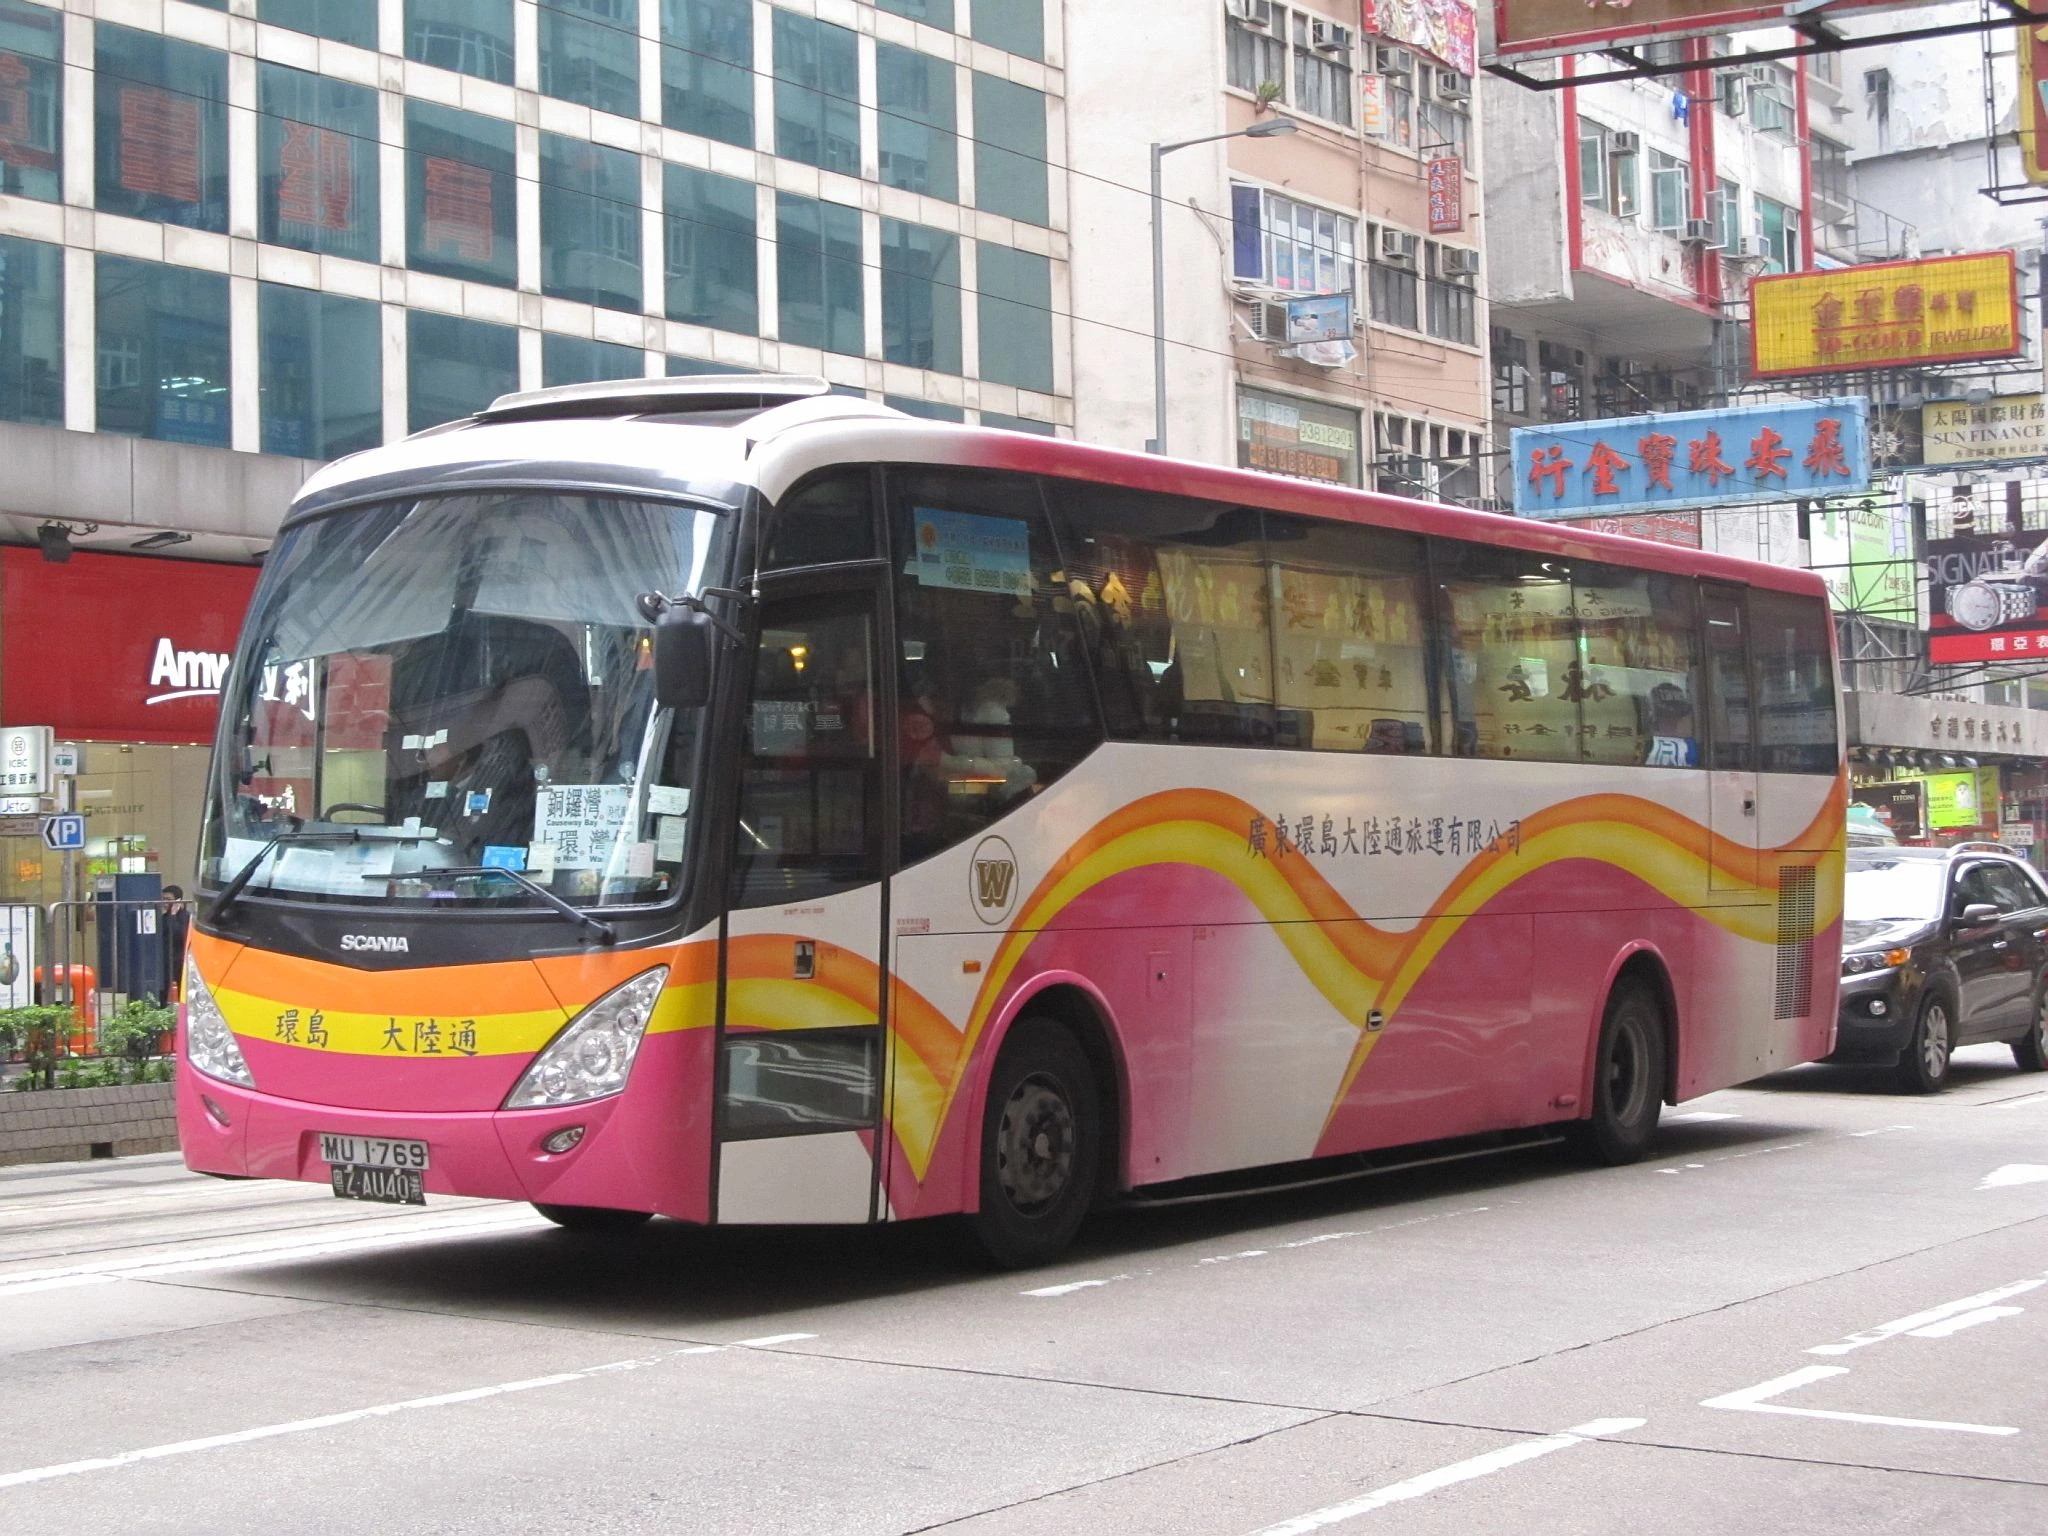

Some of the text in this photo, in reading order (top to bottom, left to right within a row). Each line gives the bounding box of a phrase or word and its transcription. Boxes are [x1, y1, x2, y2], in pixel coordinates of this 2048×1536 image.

[1930, 325, 2008, 346] JEWELLERY
[1934, 424, 2045, 446] SUN FINANCE
[9, 759, 28, 768] ICBC
[546, 787, 601, 819] 銅鑼灣
[62, 821, 77, 842] P
[546, 819, 582, 827] Causeway
[584, 819, 598, 827] Bay
[1247, 813, 1521, 858] 廣東環島大陸通旅運有限公司
[340, 934, 409, 952] SCANIA
[275, 1009, 479, 1056] 環島 大陸通
[324, 1136, 425, 1167] MU 1769
